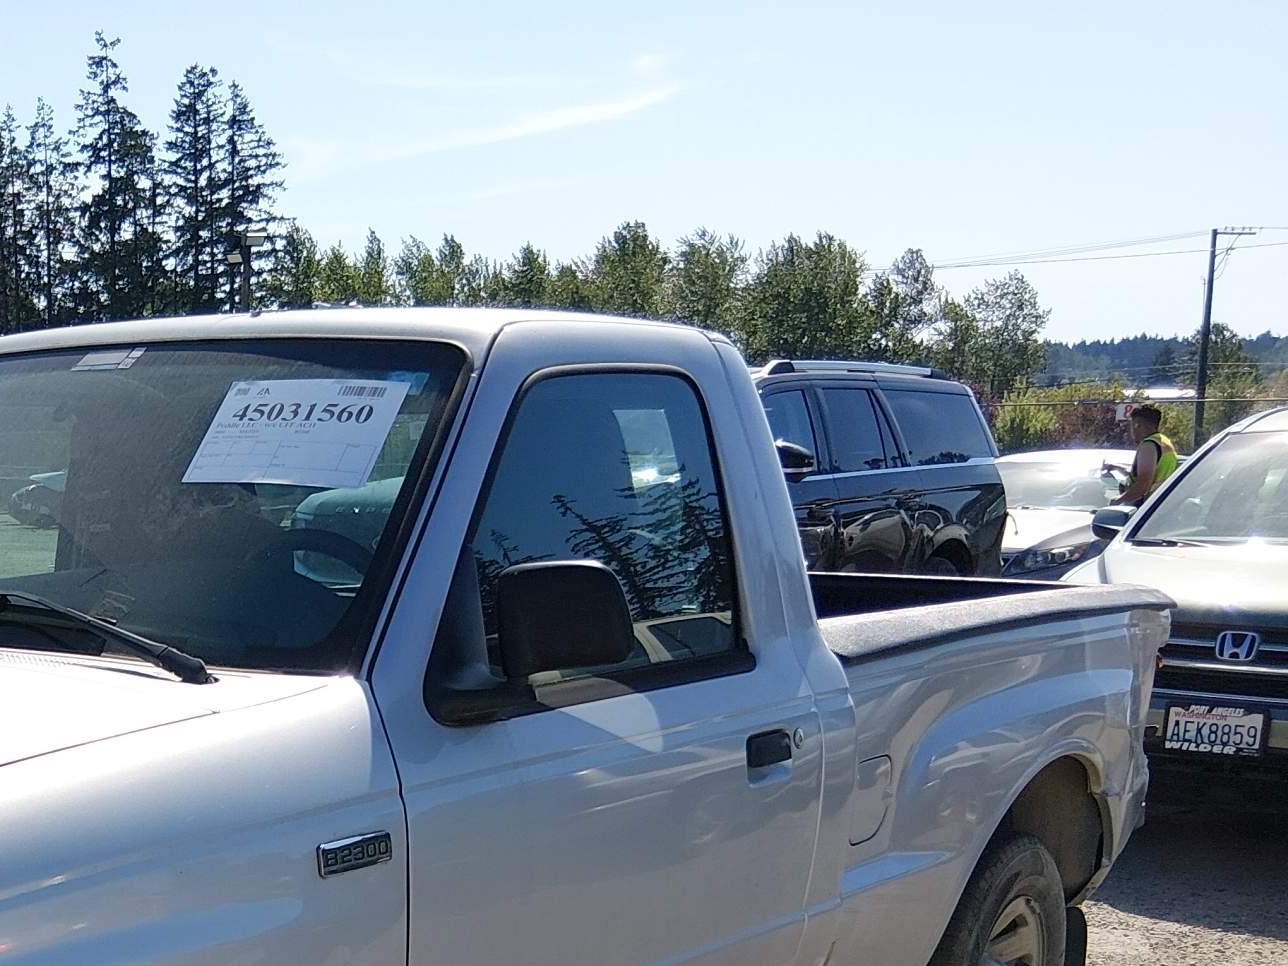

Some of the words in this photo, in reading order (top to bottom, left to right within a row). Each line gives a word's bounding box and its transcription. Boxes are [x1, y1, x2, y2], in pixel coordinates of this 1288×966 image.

[232, 402, 374, 424] 45031560
[1170, 719, 1258, 747] AEK8859
[1165, 740, 1237, 755] WILDER
[324, 839, 389, 867] B2300
